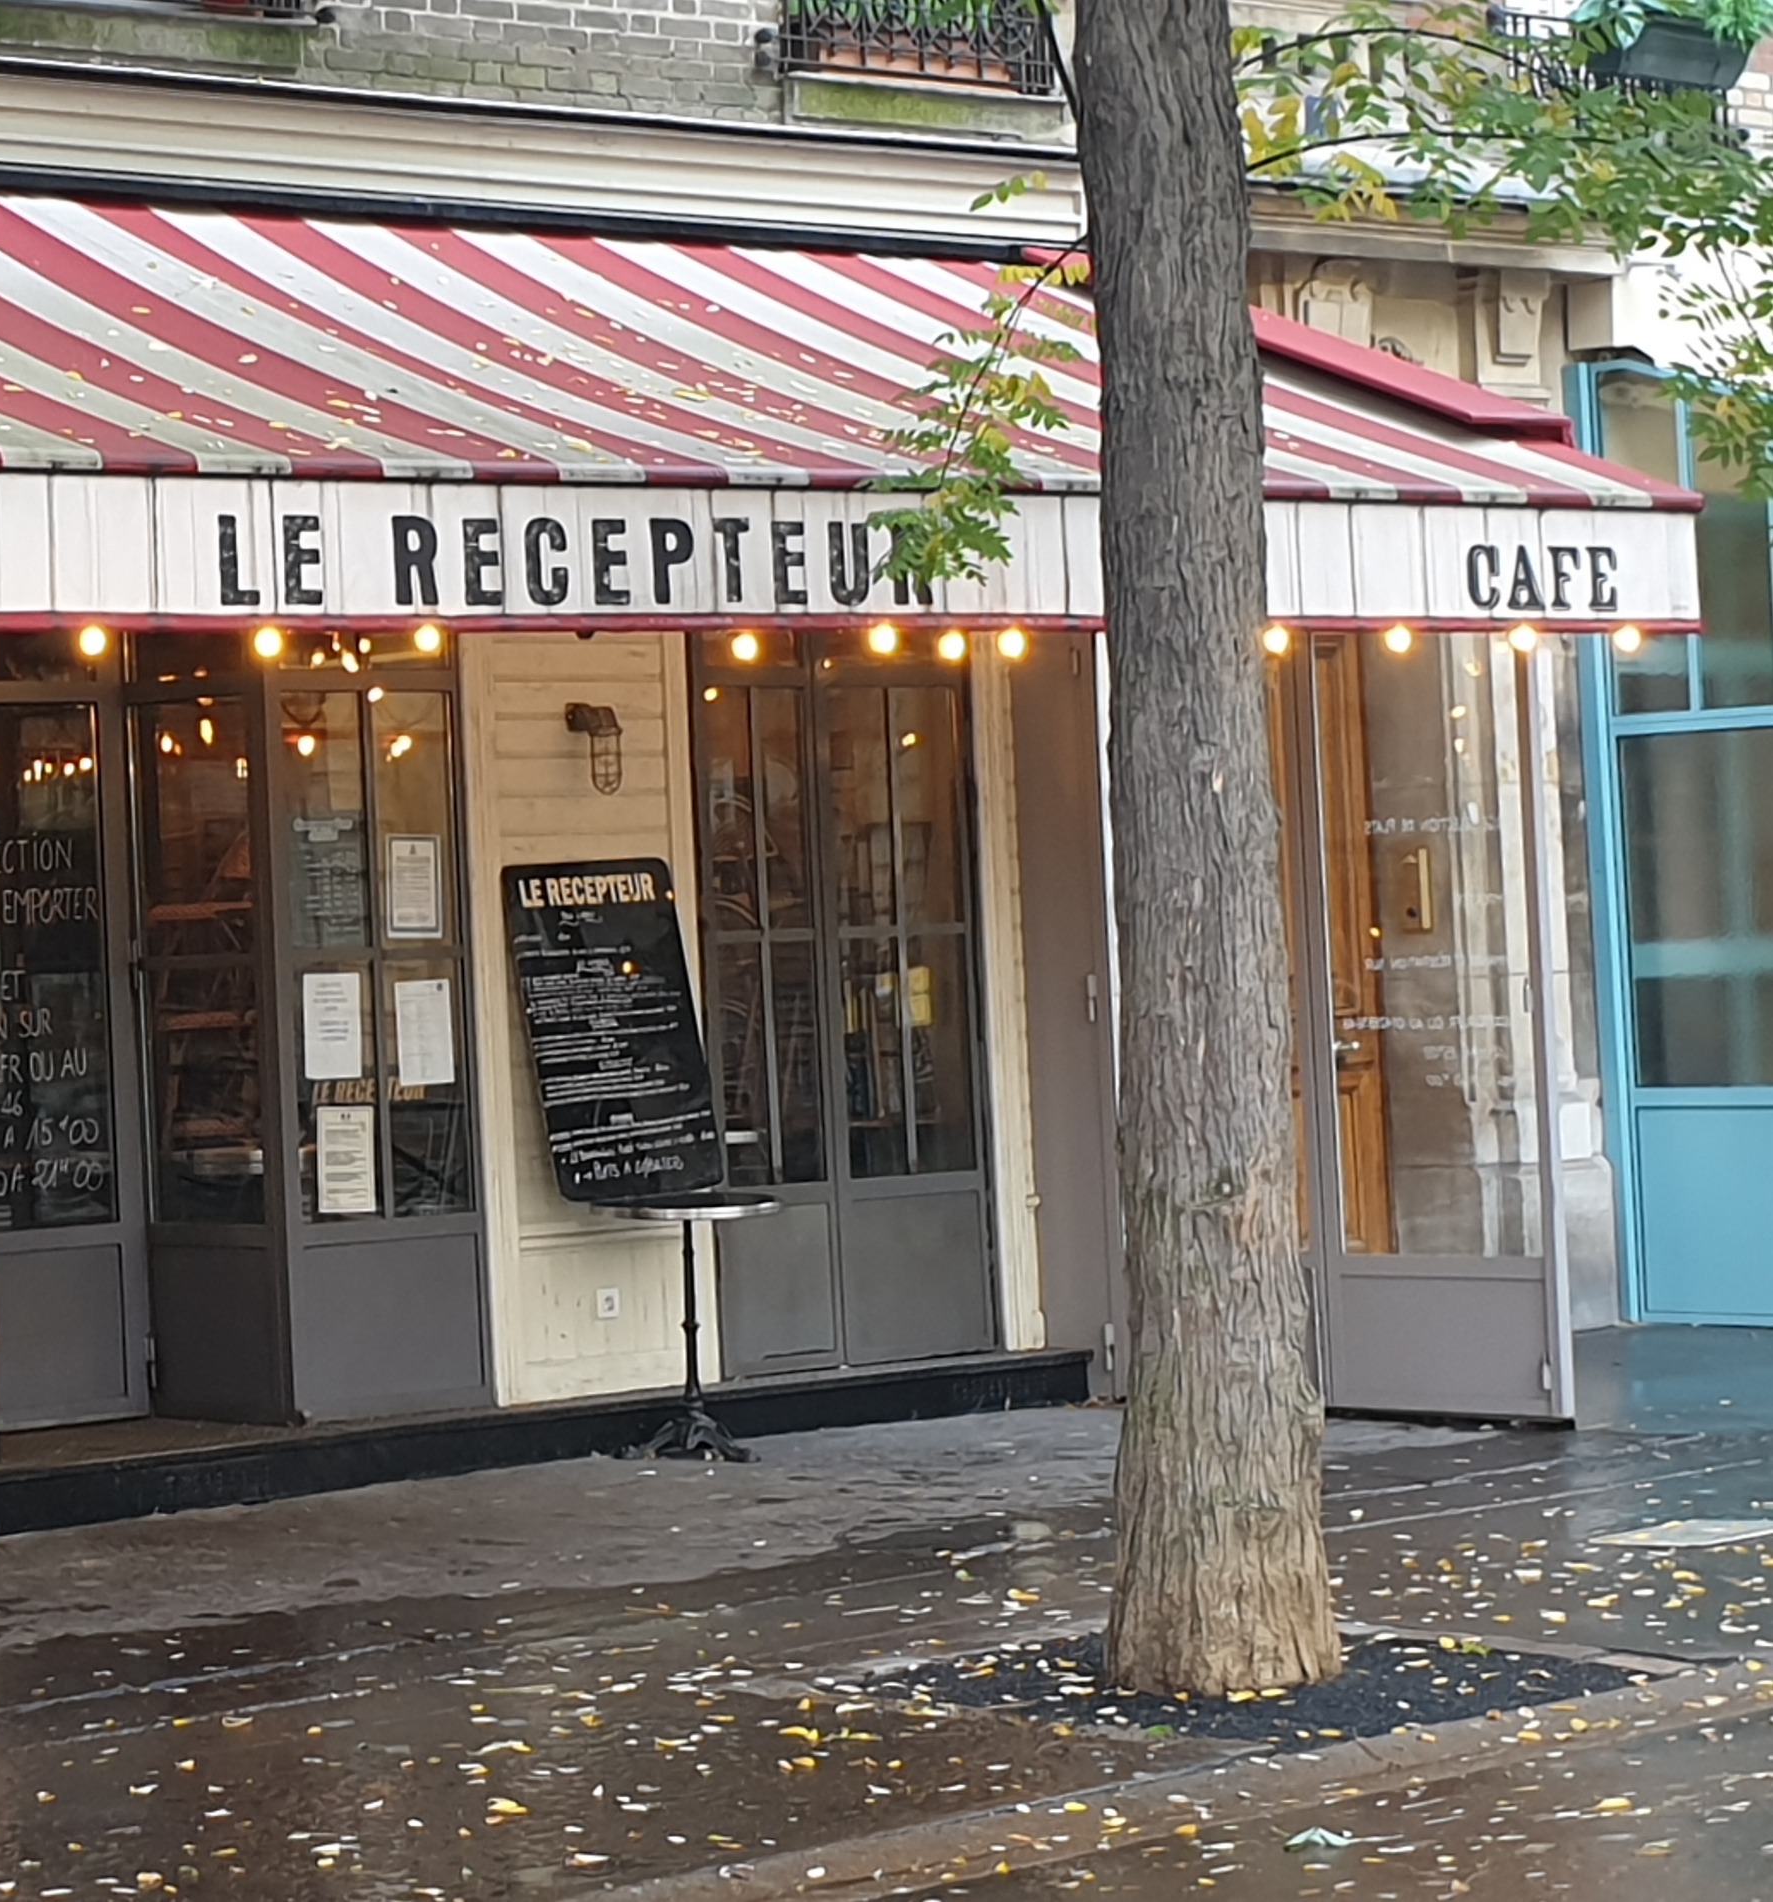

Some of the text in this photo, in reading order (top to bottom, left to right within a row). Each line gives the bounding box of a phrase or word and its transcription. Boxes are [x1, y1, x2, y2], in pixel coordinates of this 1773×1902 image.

[218, 515, 322, 605] LE
[1466, 544, 1618, 612] CAFE
[2, 887, 98, 925] EMPORTER
[518, 872, 656, 908] LE RECEPTEUR
[1, 970, 26, 1001] ET
[18, 1007, 53, 1038] SUR
[30, 1050, 54, 1082] OU
[61, 1047, 87, 1078] AU
[1, 1090, 23, 1116] 46
[4, 1125, 15, 1149] A
[11, 1163, 25, 1192] A
